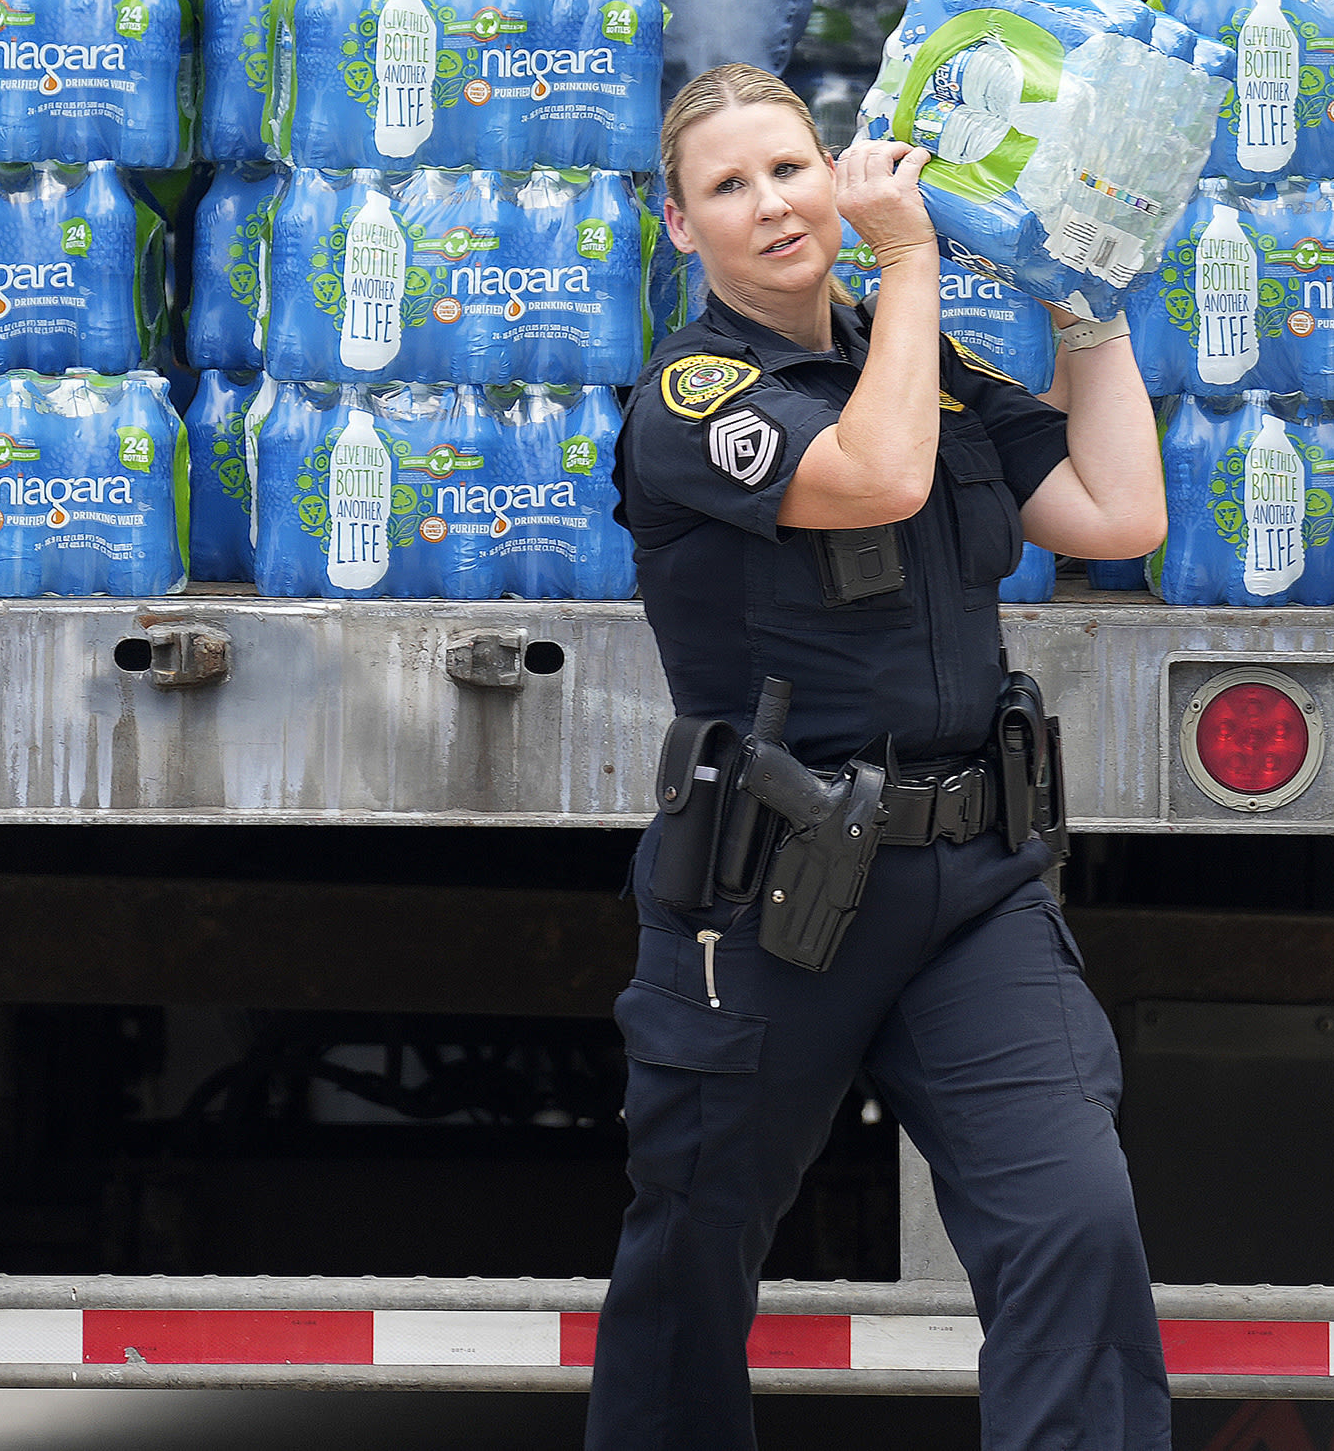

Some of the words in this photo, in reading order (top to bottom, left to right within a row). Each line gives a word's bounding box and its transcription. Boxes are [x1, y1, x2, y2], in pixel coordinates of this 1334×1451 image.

[120, 6, 142, 23] 24
[383, 9, 408, 30] GIVE
[409, 12, 430, 33] THIS
[607, 10, 631, 26] 24
[605, 25, 631, 34] BOTTLES
[1243, 25, 1270, 46] GIVE
[1270, 27, 1292, 49] THIS
[383, 33, 429, 63] BOTTLE
[383, 64, 427, 84] ANOTHER
[481, 44, 615, 101] niagara
[1244, 50, 1292, 80] BOTTLE
[0, 80, 38, 91] PURIFIED
[65, 78, 109, 90] DRINKING
[110, 79, 136, 93] WATER
[494, 87, 531, 98] PURIFIED
[553, 83, 600, 93] DRINKING
[600, 84, 627, 96] WATER
[1245, 81, 1289, 102] ANOTHER
[385, 88, 424, 127] LIFE
[1246, 104, 1288, 146] LIFE
[67, 225, 85, 241] 24
[351, 222, 377, 243] GIVE
[378, 226, 399, 249] THIS
[582, 227, 607, 243] 24
[581, 242, 607, 252] BOTTLES
[1200, 238, 1226, 260] GIVE
[1227, 240, 1250, 263] THIS
[351, 248, 398, 279] BOTTLE
[865, 272, 1002, 300] nara
[1202, 263, 1250, 291] BOTTLE
[351, 278, 395, 301] ANOTHER
[451, 263, 590, 322] niagara
[14, 297, 59, 307] DRINKING
[59, 296, 86, 307] WATER
[464, 304, 504, 316] PURIFIED
[528, 301, 573, 311] DRINKING
[573, 302, 602, 314] WATER
[1203, 294, 1250, 312] ANOTHER
[350, 302, 393, 343] LIFE
[942, 309, 987, 318] DRINKING
[988, 310, 1015, 321] WATER
[1206, 316, 1249, 357] LIFE
[680, 387, 727, 406] POLICE
[123, 438, 149, 455] 24
[335, 444, 361, 466] GIVE
[362, 446, 384, 468] THIS
[567, 442, 590, 458] 24
[123, 454, 149, 463] BOTTLES
[1250, 447, 1276, 469] GIVE
[1277, 451, 1297, 474] THIS
[335, 470, 384, 499] BOTTLE
[1250, 473, 1298, 503] BOTTLE
[6, 515, 45, 526] PURIFIED
[73, 512, 117, 524] DRINKING
[117, 514, 144, 526] WATER
[336, 500, 382, 521] ANOTHER
[437, 481, 576, 538] niagara
[1253, 505, 1296, 524] ANOTHER
[450, 523, 489, 535] PURIFIED
[514, 516, 560, 527] DRINKING
[561, 516, 588, 528] WATER
[335, 524, 380, 564] LIFE
[1254, 528, 1297, 572] LIFE
